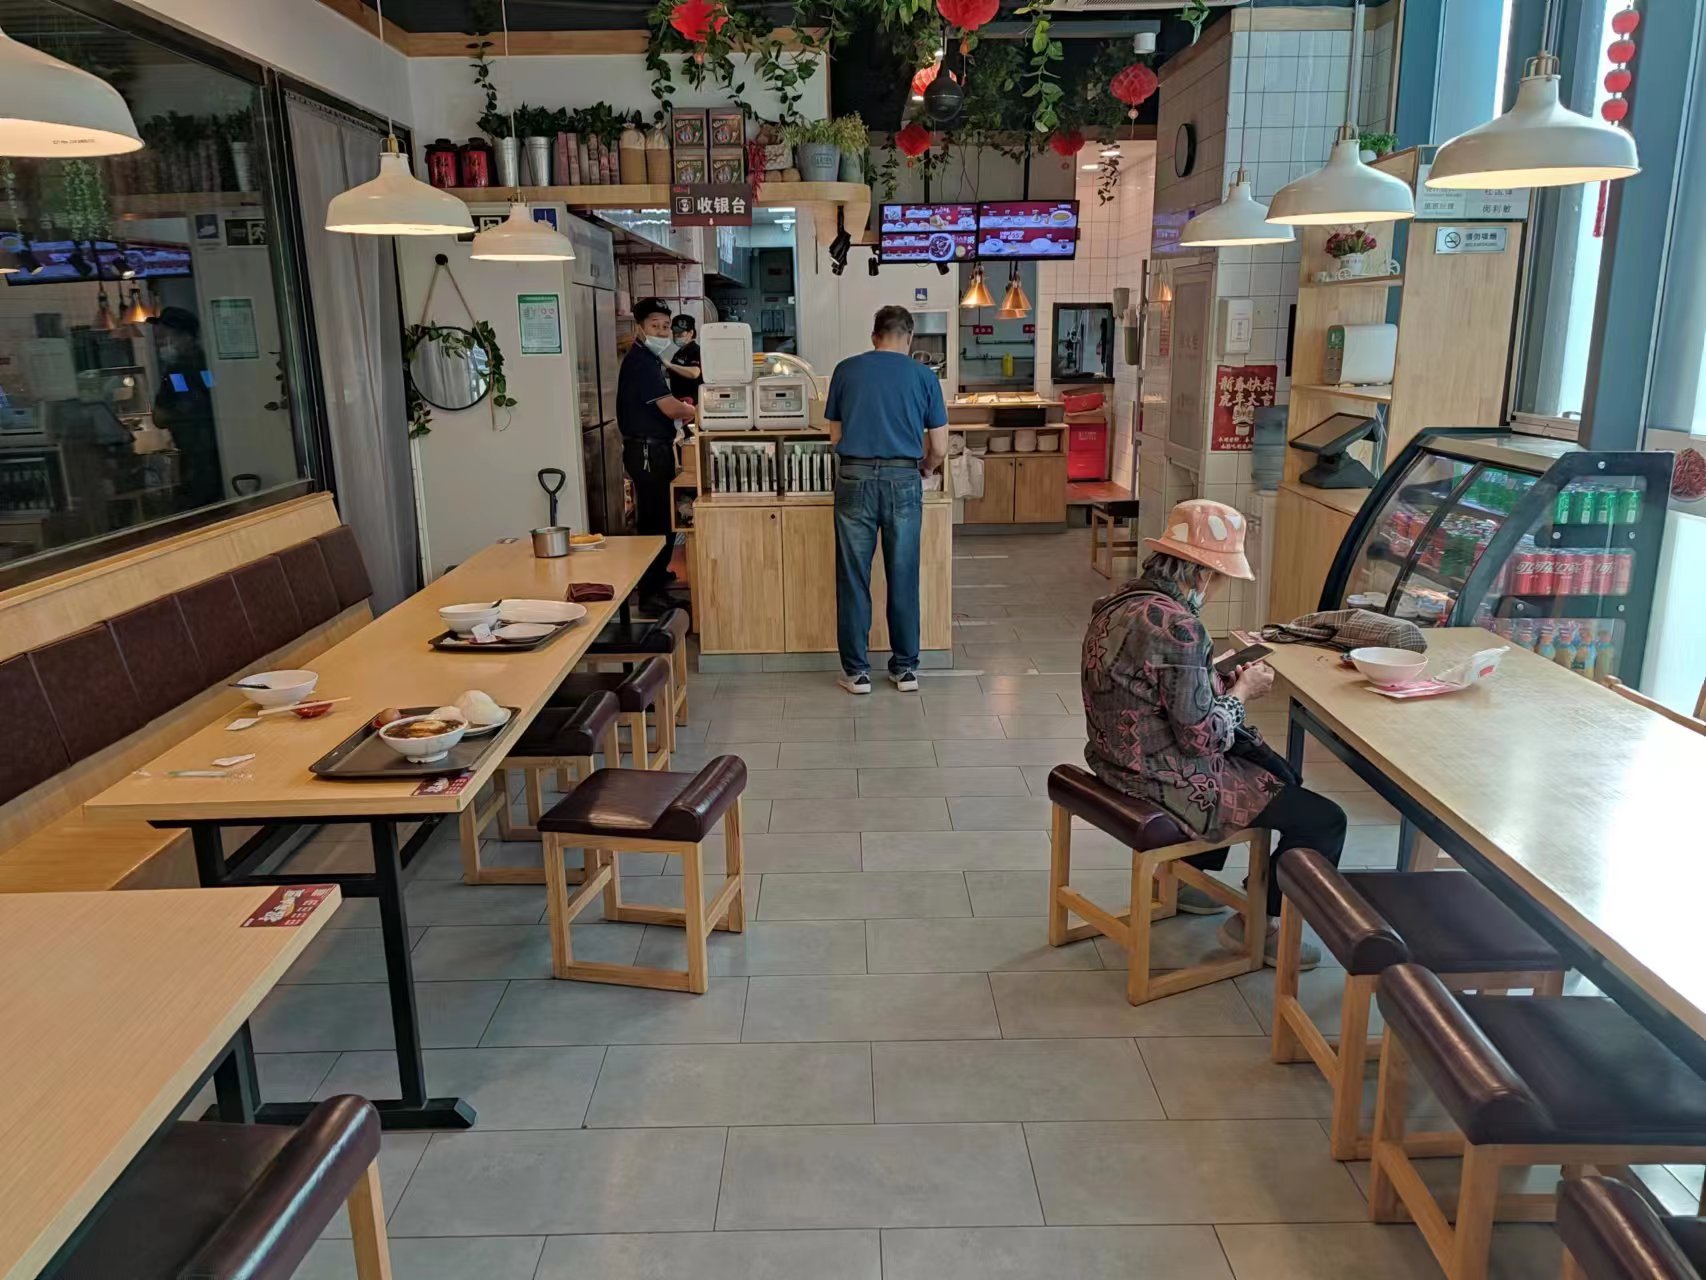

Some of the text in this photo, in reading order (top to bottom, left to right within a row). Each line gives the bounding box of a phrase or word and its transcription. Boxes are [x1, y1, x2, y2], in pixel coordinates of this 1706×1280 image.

[697, 197, 746, 214] 收银台
[1218, 376, 1274, 392] 新春快乐
[1218, 391, 1273, 408] 虎年大吉
